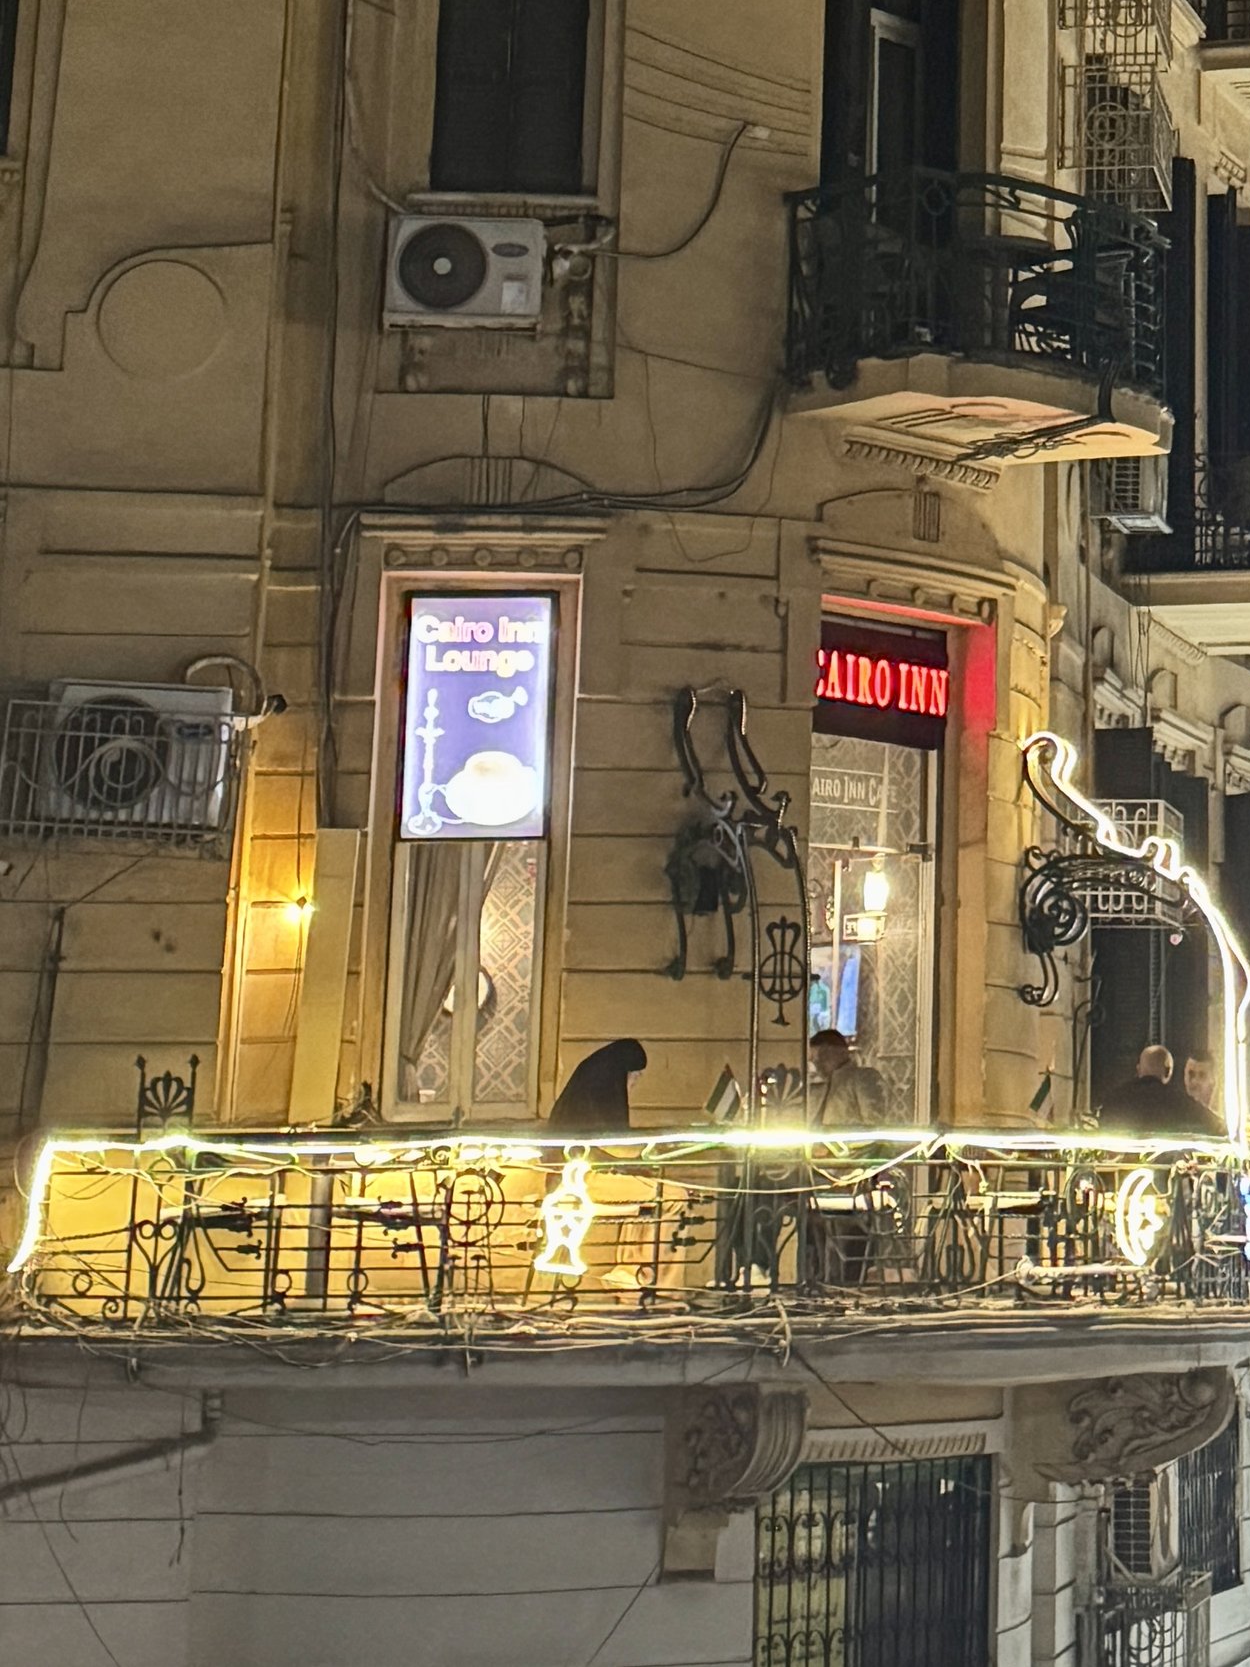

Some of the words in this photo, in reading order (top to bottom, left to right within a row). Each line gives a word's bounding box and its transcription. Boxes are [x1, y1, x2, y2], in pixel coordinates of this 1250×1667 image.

[416, 615, 495, 644] Cairo
[498, 616, 544, 644] Inn
[425, 645, 535, 678] Lounge
[898, 662, 949, 716] INN
